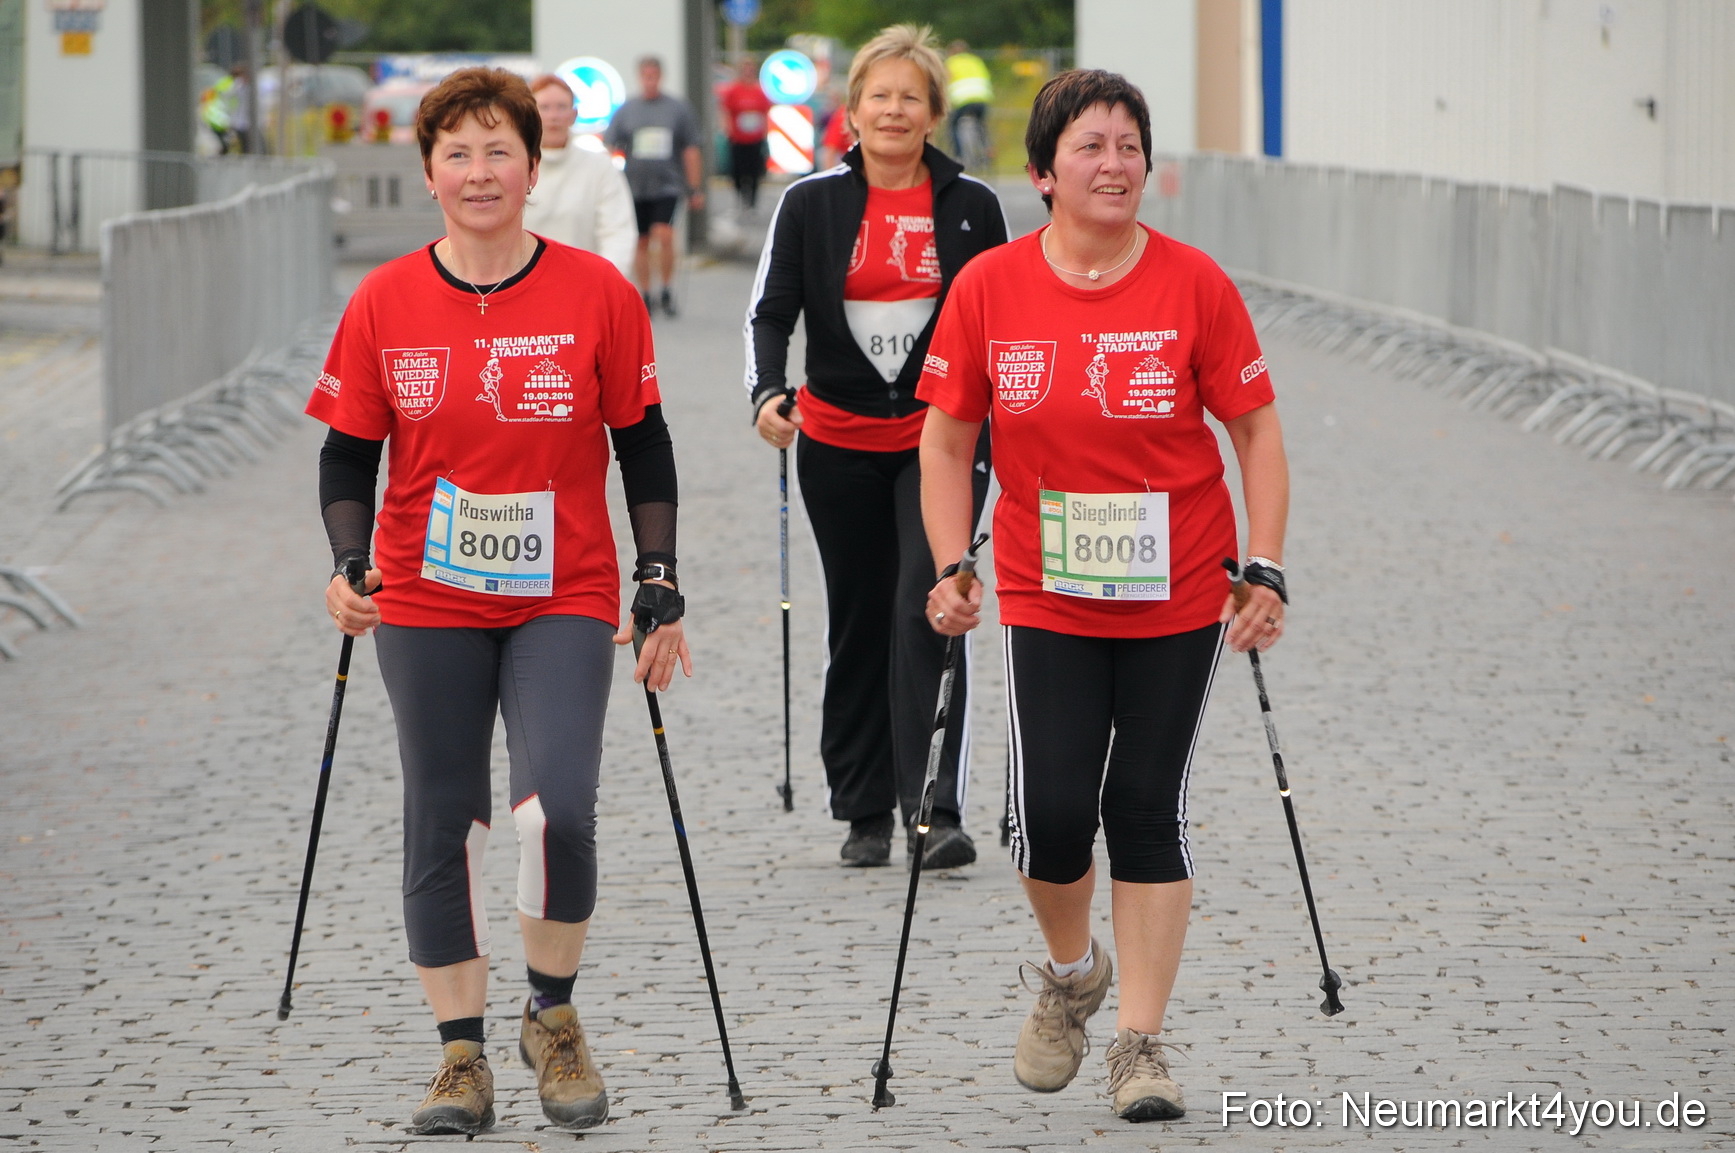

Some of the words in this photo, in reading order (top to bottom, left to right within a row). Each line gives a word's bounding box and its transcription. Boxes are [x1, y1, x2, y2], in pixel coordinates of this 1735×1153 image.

[474, 338, 491, 348] 11.
[492, 333, 575, 347] NEUMARKTER
[1081, 334, 1097, 343] 11.
[1099, 329, 1178, 343] NEUMARKTER
[490, 345, 558, 357] STADTLAUF
[1096, 341, 1163, 353] STADTLAUF
[999, 350, 1044, 362] IMMER
[393, 357, 438, 370] IMMER
[996, 362, 1045, 373] WIEDER
[392, 369, 439, 381] WIEDER
[998, 373, 1042, 389] NEU
[396, 380, 436, 397] NEU
[1128, 388, 1176, 396] 19.09.2010
[522, 392, 574, 400] 19.09.2010
[999, 390, 1039, 401] MARKT
[399, 397, 434, 408] MARKT
[459, 498, 534, 522] Roswitha
[1072, 500, 1147, 526] Sieglinde
[459, 530, 542, 562] 8009
[1074, 534, 1157, 564] 8008
[499, 579, 551, 589] PFLEIDERER
[1117, 583, 1168, 593] PFLEIDERER
